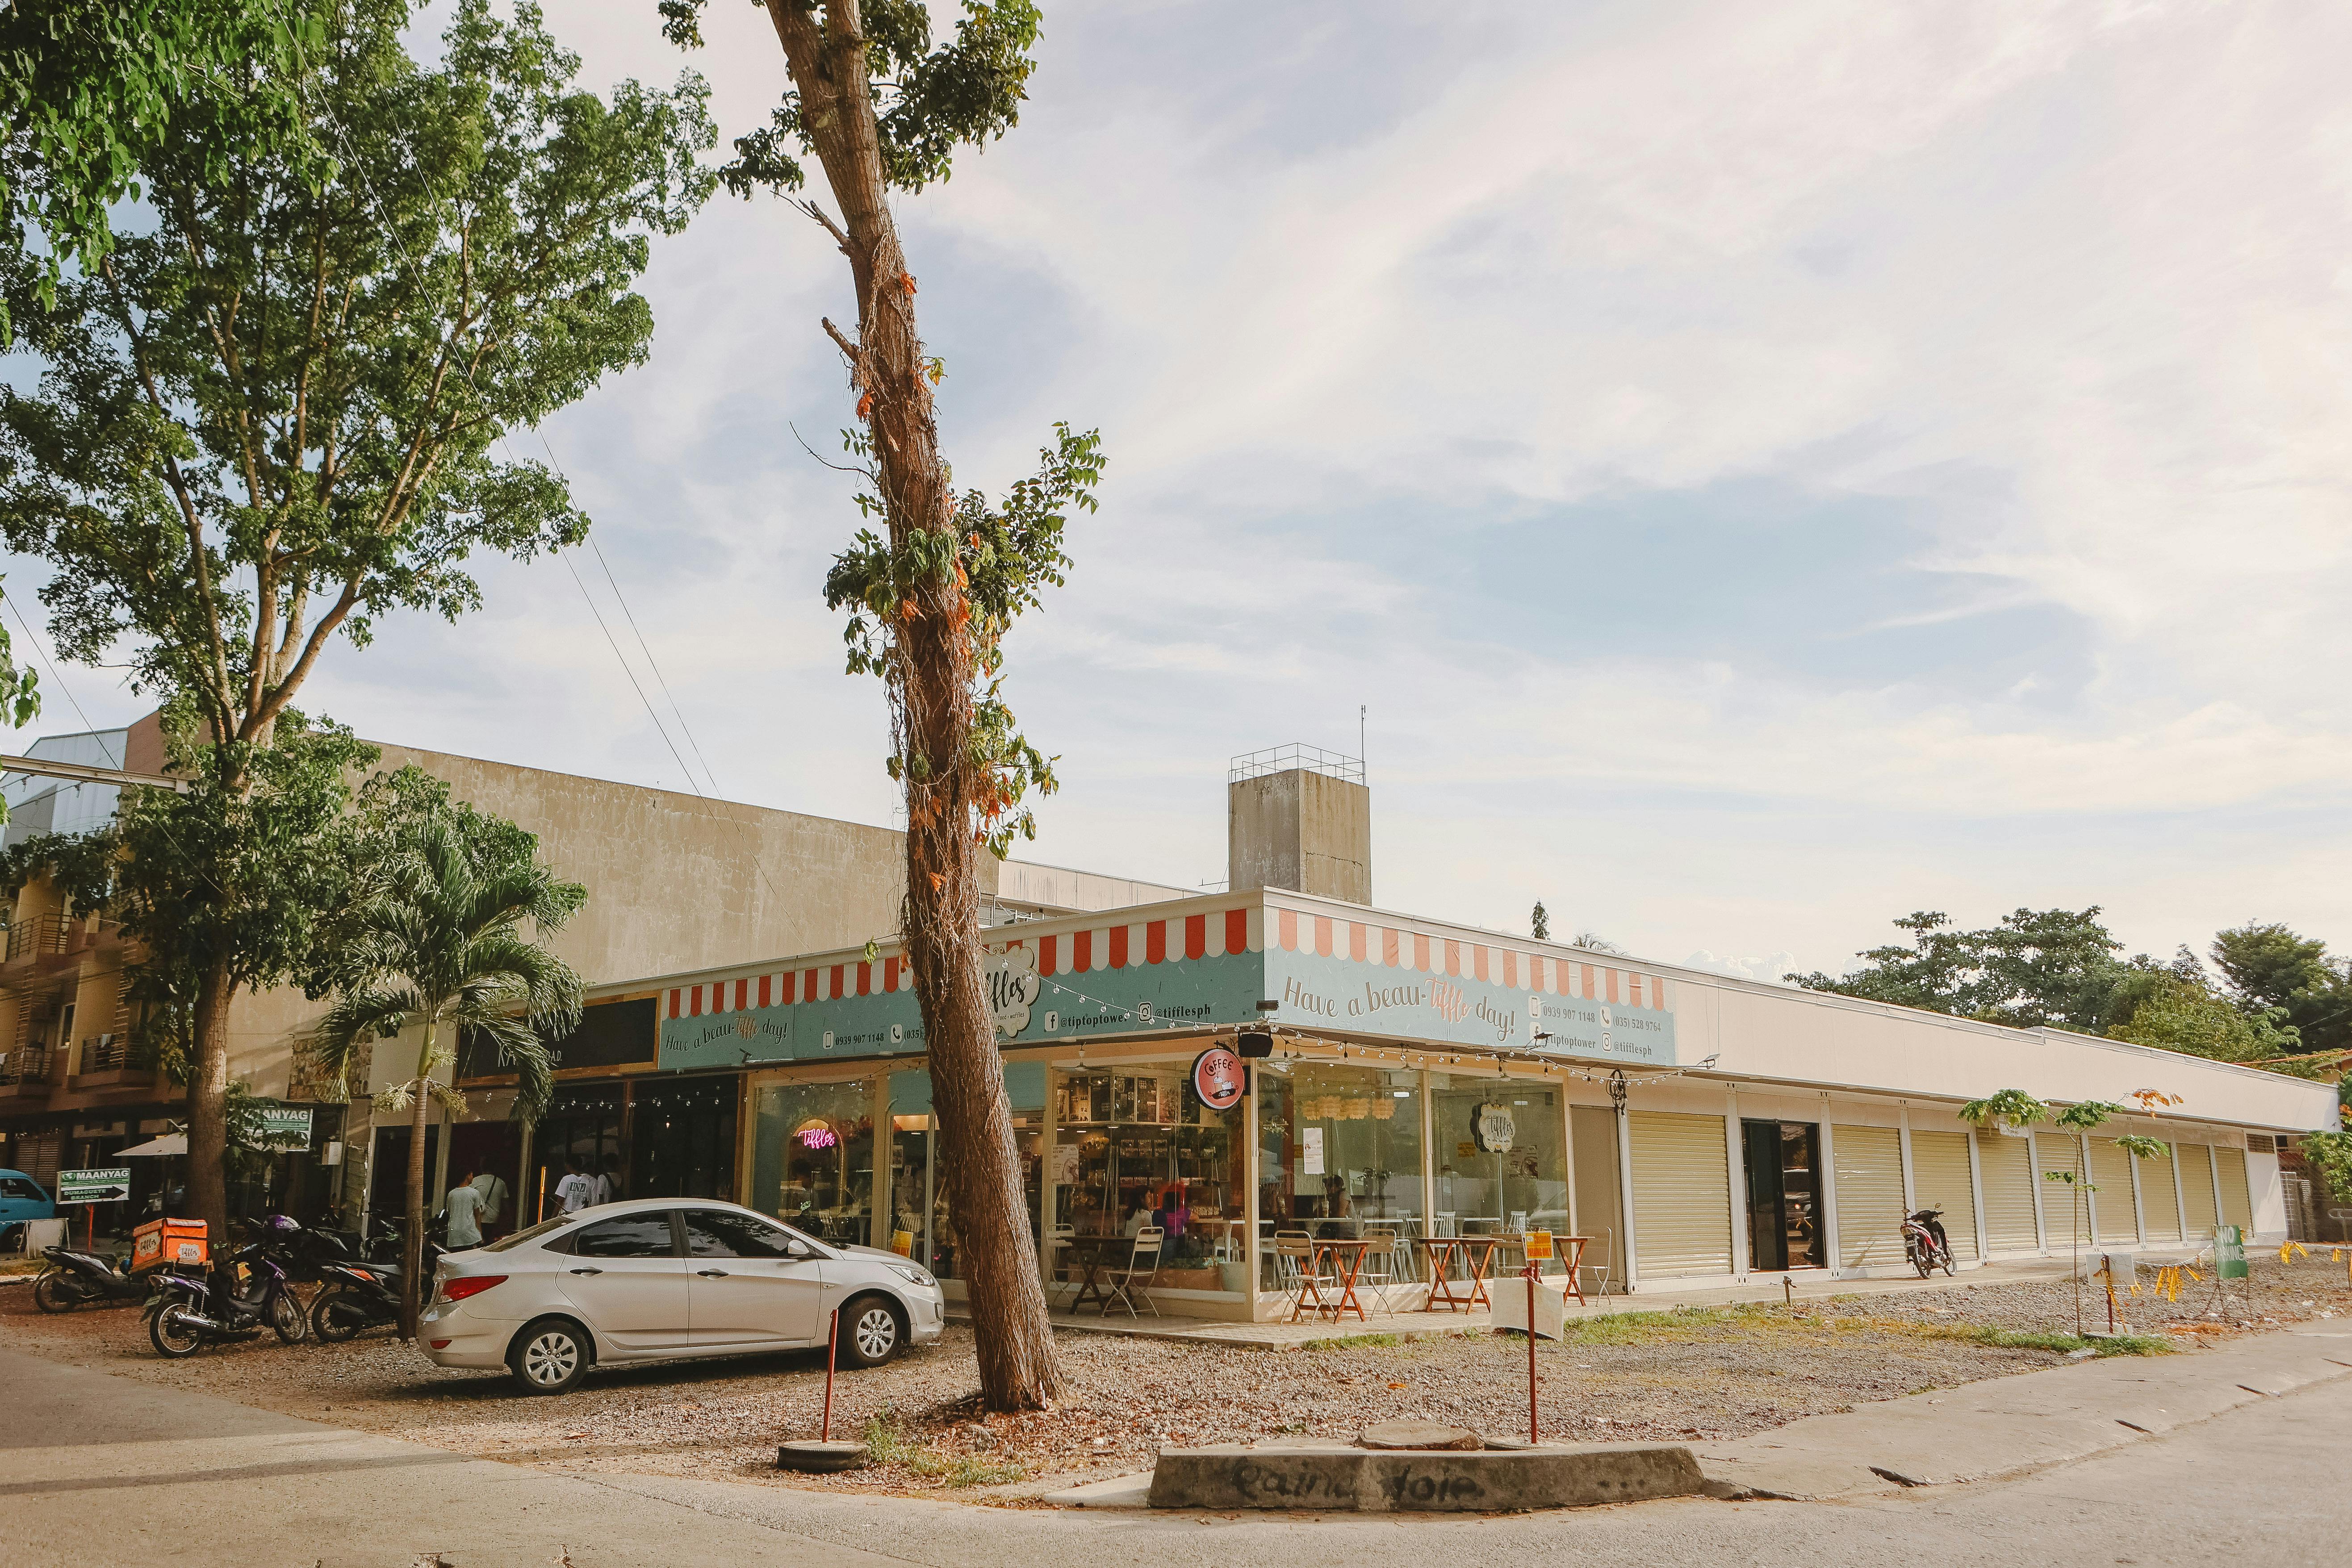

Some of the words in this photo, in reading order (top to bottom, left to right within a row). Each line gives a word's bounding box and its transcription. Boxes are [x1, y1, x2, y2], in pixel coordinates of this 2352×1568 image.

[986, 970, 1026, 1013] fles
[1155, 1004, 1211, 1019] @tifflesph
[1284, 976, 1339, 1017] Have
[1348, 997, 1365, 1017] a
[1476, 996, 1515, 1041] day!
[1543, 1006, 1561, 1017] 0939
[1563, 1008, 1576, 1020] 907
[1578, 1011, 1595, 1023] 1148
[1613, 1016, 1630, 1029] (035)
[1632, 1019, 1644, 1029] 528
[1646, 1021, 1661, 1032] 9764
[666, 1034, 689, 1051] Have
[694, 1037, 702, 1049] a
[762, 1018, 788, 1045] day!
[835, 1036, 851, 1045] 0939
[854, 1034, 866, 1044] 907
[868, 1033, 884, 1042] 1148
[904, 1029, 922, 1041] (035)
[1614, 1041, 1652, 1058] @tifflesph
[1204, 1059, 1233, 1076] COFFEE
[263, 1109, 309, 1120] ANYAG
[76, 1170, 129, 1179] MAANYAG
[2220, 1226, 2235, 1243] NO
[2215, 1245, 2244, 1261] PARKING
